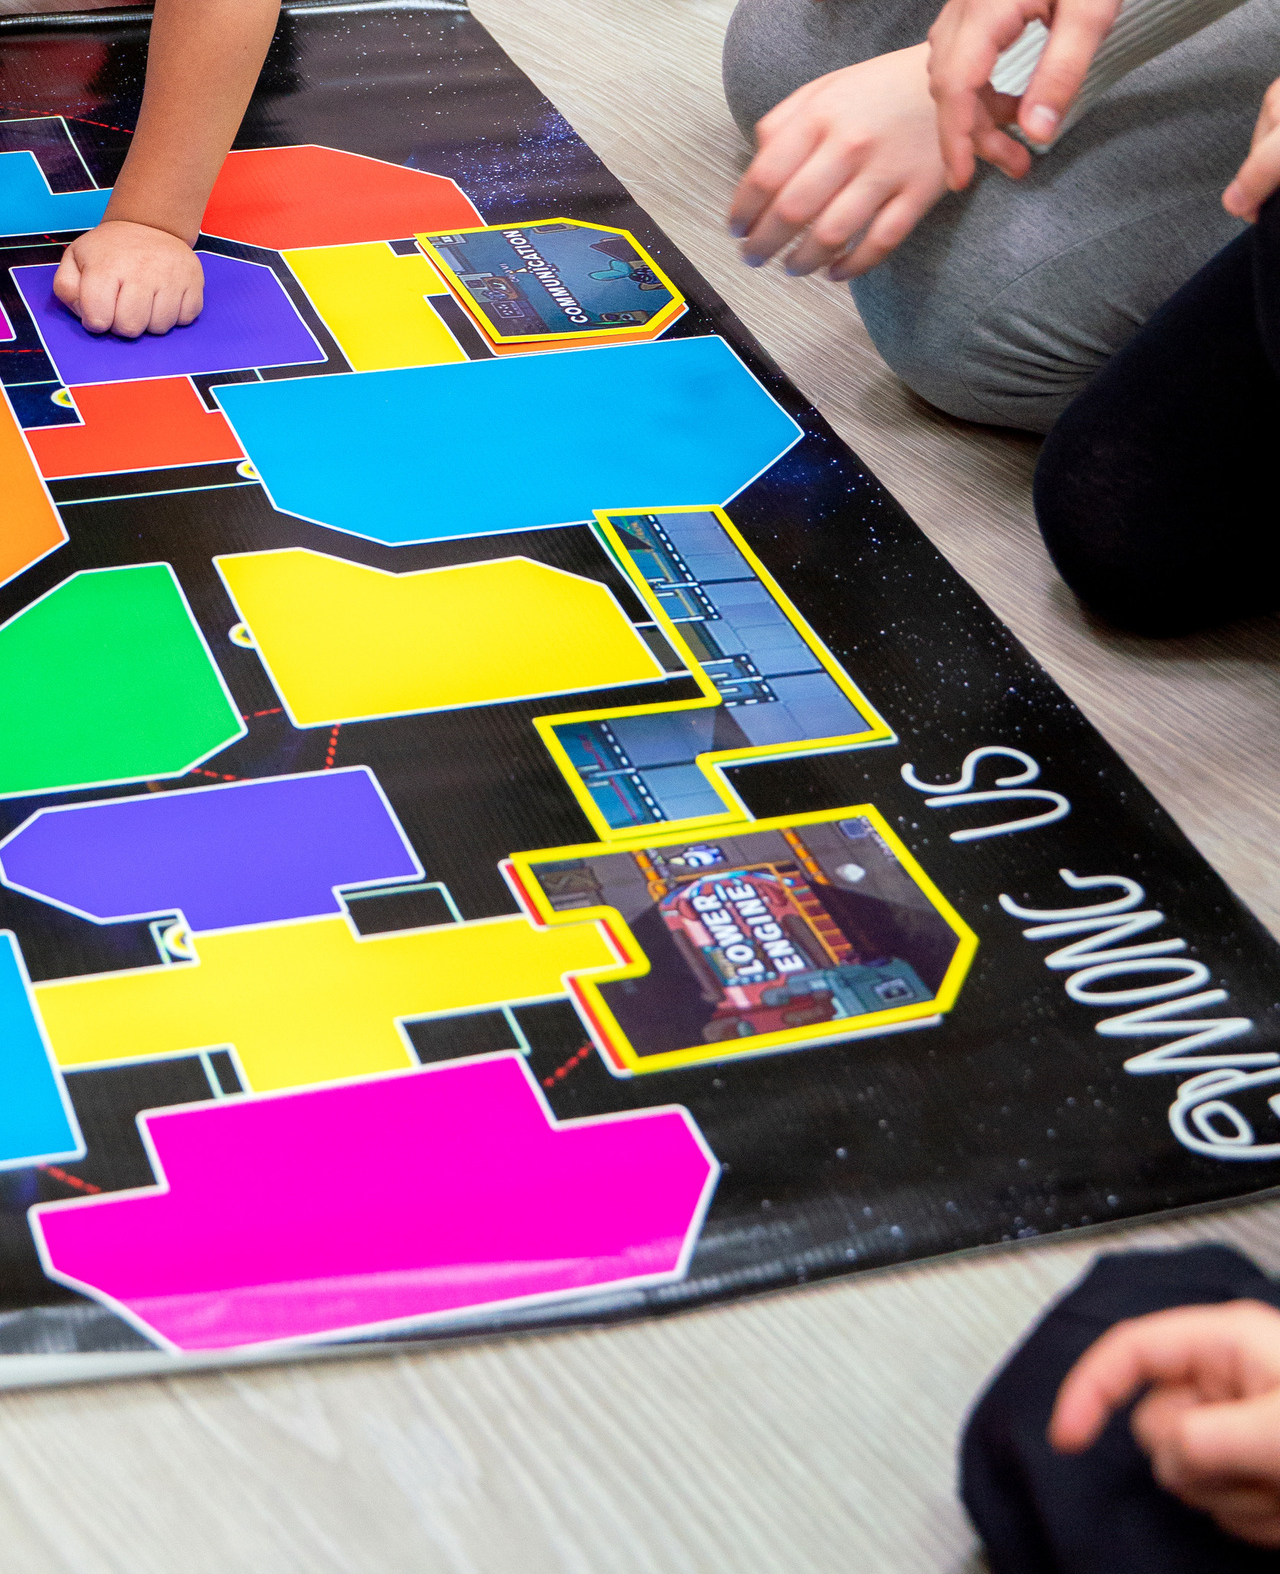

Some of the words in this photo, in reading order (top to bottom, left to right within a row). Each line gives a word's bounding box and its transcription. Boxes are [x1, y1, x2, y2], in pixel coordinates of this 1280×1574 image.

[502, 229, 589, 324] COMMUNICATION
[900, 745, 1071, 843] US
[691, 892, 765, 976] LOWER
[725, 883, 806, 973] ENGINE
